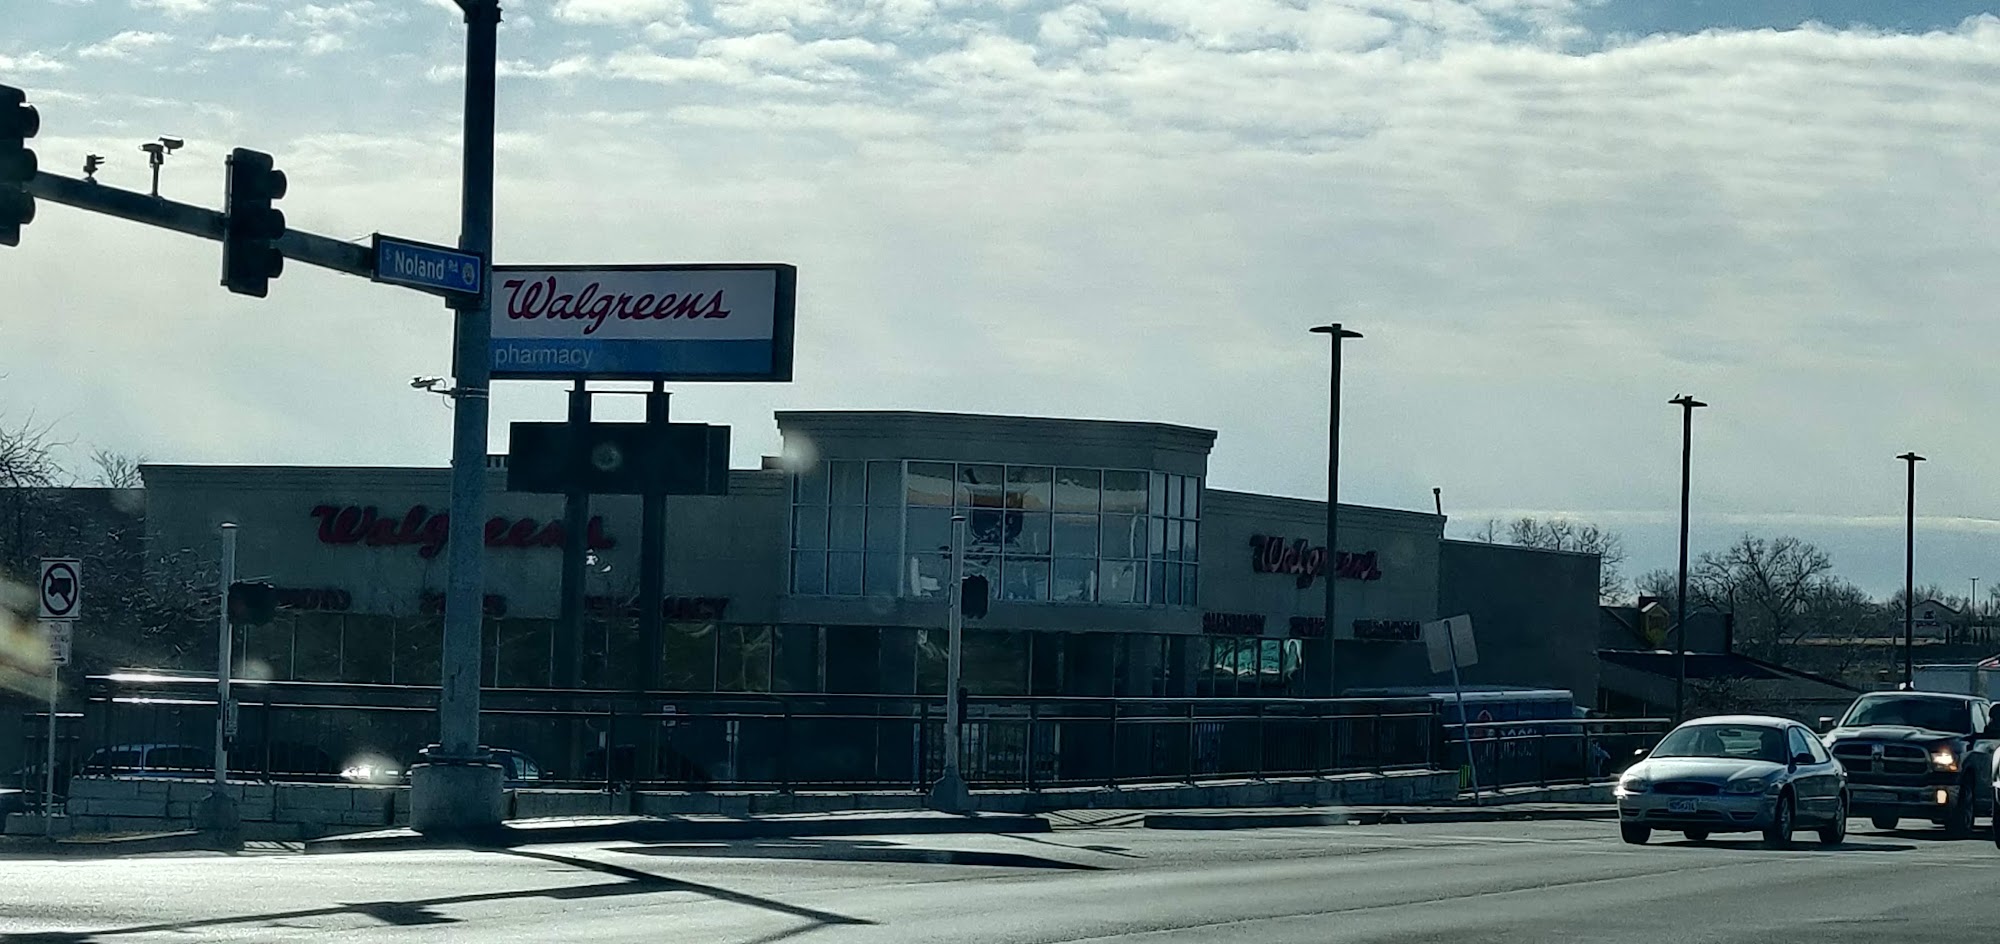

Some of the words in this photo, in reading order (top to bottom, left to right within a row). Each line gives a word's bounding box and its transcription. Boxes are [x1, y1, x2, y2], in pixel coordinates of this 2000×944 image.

[394, 251, 445, 280] Noland
[447, 259, 459, 273] Rd
[503, 275, 731, 335] Walgreens
[494, 345, 593, 369] pharmacy
